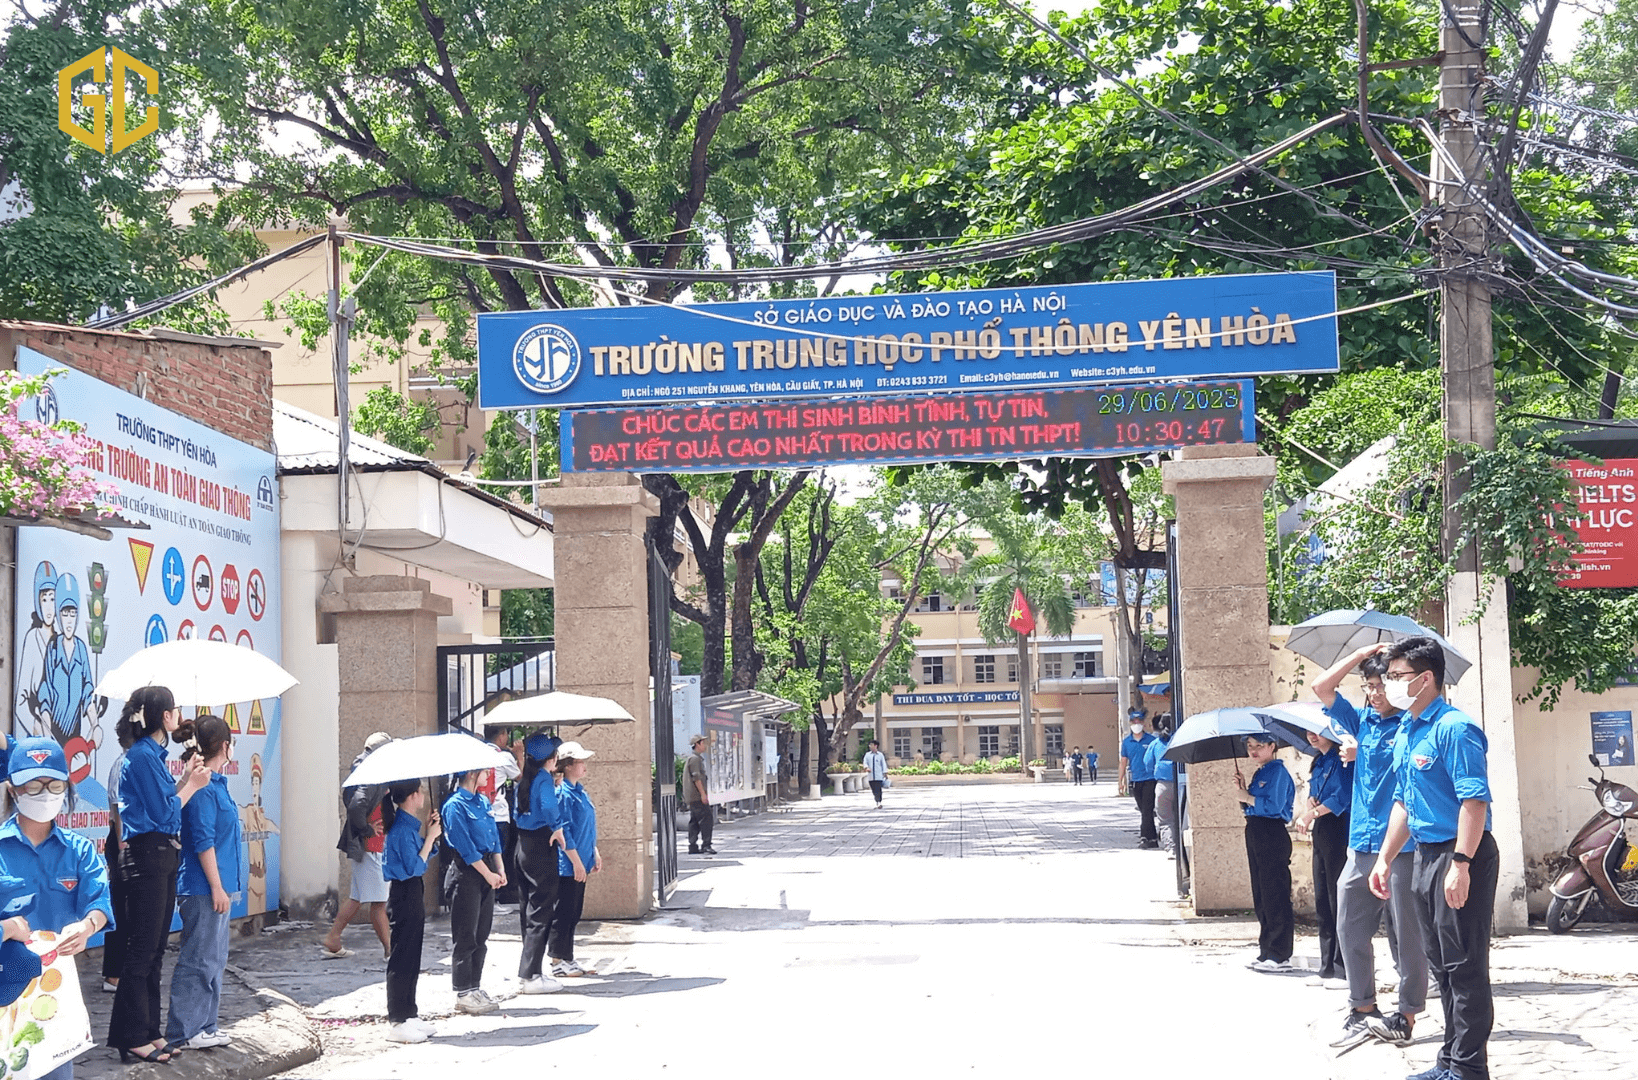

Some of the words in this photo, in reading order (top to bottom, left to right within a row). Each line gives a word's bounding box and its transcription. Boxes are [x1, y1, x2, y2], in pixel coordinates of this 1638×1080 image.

[753, 304, 779, 325] SỞ
[785, 301, 832, 323] GIÁO
[838, 305, 875, 325] DỤC
[883, 299, 906, 320] VÀ
[911, 297, 951, 317] ĐÀO
[958, 299, 993, 321] TẠO
[1001, 292, 1026, 313] HÀ
[1033, 292, 1066, 315] NỘI
[589, 334, 724, 375] TRƯỜNG
[733, 338, 847, 371] TRUNG
[854, 333, 923, 371] HỌC
[931, 316, 1002, 362] PHỔ
[1009, 317, 1128, 357] THÔNG
[1138, 311, 1211, 351] YÊN
[1220, 306, 1296, 346] HÒA
[621, 388, 635, 400] ĐỊA
[672, 387, 686, 396] 251
[687, 382, 718, 395] NGUYỄN
[720, 384, 749, 394] KHANG,
[750, 382, 765, 393] YÊN
[766, 381, 784, 393] HÒA,
[785, 379, 801, 391] CẦU
[802, 378, 821, 390] GIẤY,
[823, 380, 835, 389] TP.
[836, 378, 847, 388] HÀ
[850, 377, 864, 390] NỘI
[890, 377, 910, 386] 0243
[912, 376, 927, 385] 833
[928, 375, 947, 384] 3721
[959, 373, 983, 383] Email:
[1070, 367, 1105, 378] Website:
[622, 410, 681, 435] CHÚC
[684, 408, 725, 432] CÁC
[729, 410, 759, 430] EM
[763, 405, 797, 429] THÍ
[803, 406, 853, 428] SINH
[858, 403, 910, 426] BÌNH
[974, 399, 1005, 423] TỰ
[1007, 397, 1049, 419] TIN,
[1098, 388, 1239, 415] 29/06/2023
[116, 412, 156, 445] TRƯỜNG
[157, 430, 180, 453] THPT
[181, 438, 198, 461] YÊN
[199, 445, 217, 468] HÒA
[588, 442, 631, 465] ĐẠT
[635, 437, 672, 461] KẾT
[676, 434, 723, 460] QUẢ
[727, 437, 771, 458] CAO
[775, 431, 834, 456] NHẤT
[837, 430, 913, 453] TRONG
[916, 427, 943, 449] KỲ
[946, 427, 982, 448] THI
[986, 426, 1016, 447] TN
[1020, 422, 1081, 445] THPT!
[1115, 418, 1226, 443] 10:30:47
[107, 445, 151, 489] TRƯỜNG
[153, 462, 168, 495] AN
[170, 466, 197, 504] TOÀN
[199, 478, 221, 512] GIAO
[222, 484, 251, 521] THÔNG
[1575, 467, 1608, 479] Tiếng
[1609, 467, 1634, 477] Anh
[1588, 508, 1634, 533] LỰC
[222, 578, 239, 601] STOP
[896, 695, 913, 704] THI
[936, 695, 954, 704] DẠY
[956, 692, 975, 702] TỐT
[984, 693, 1004, 703] HỌC
[1005, 690, 1020, 701] TỐ
[71, 812, 89, 829] GIAO
